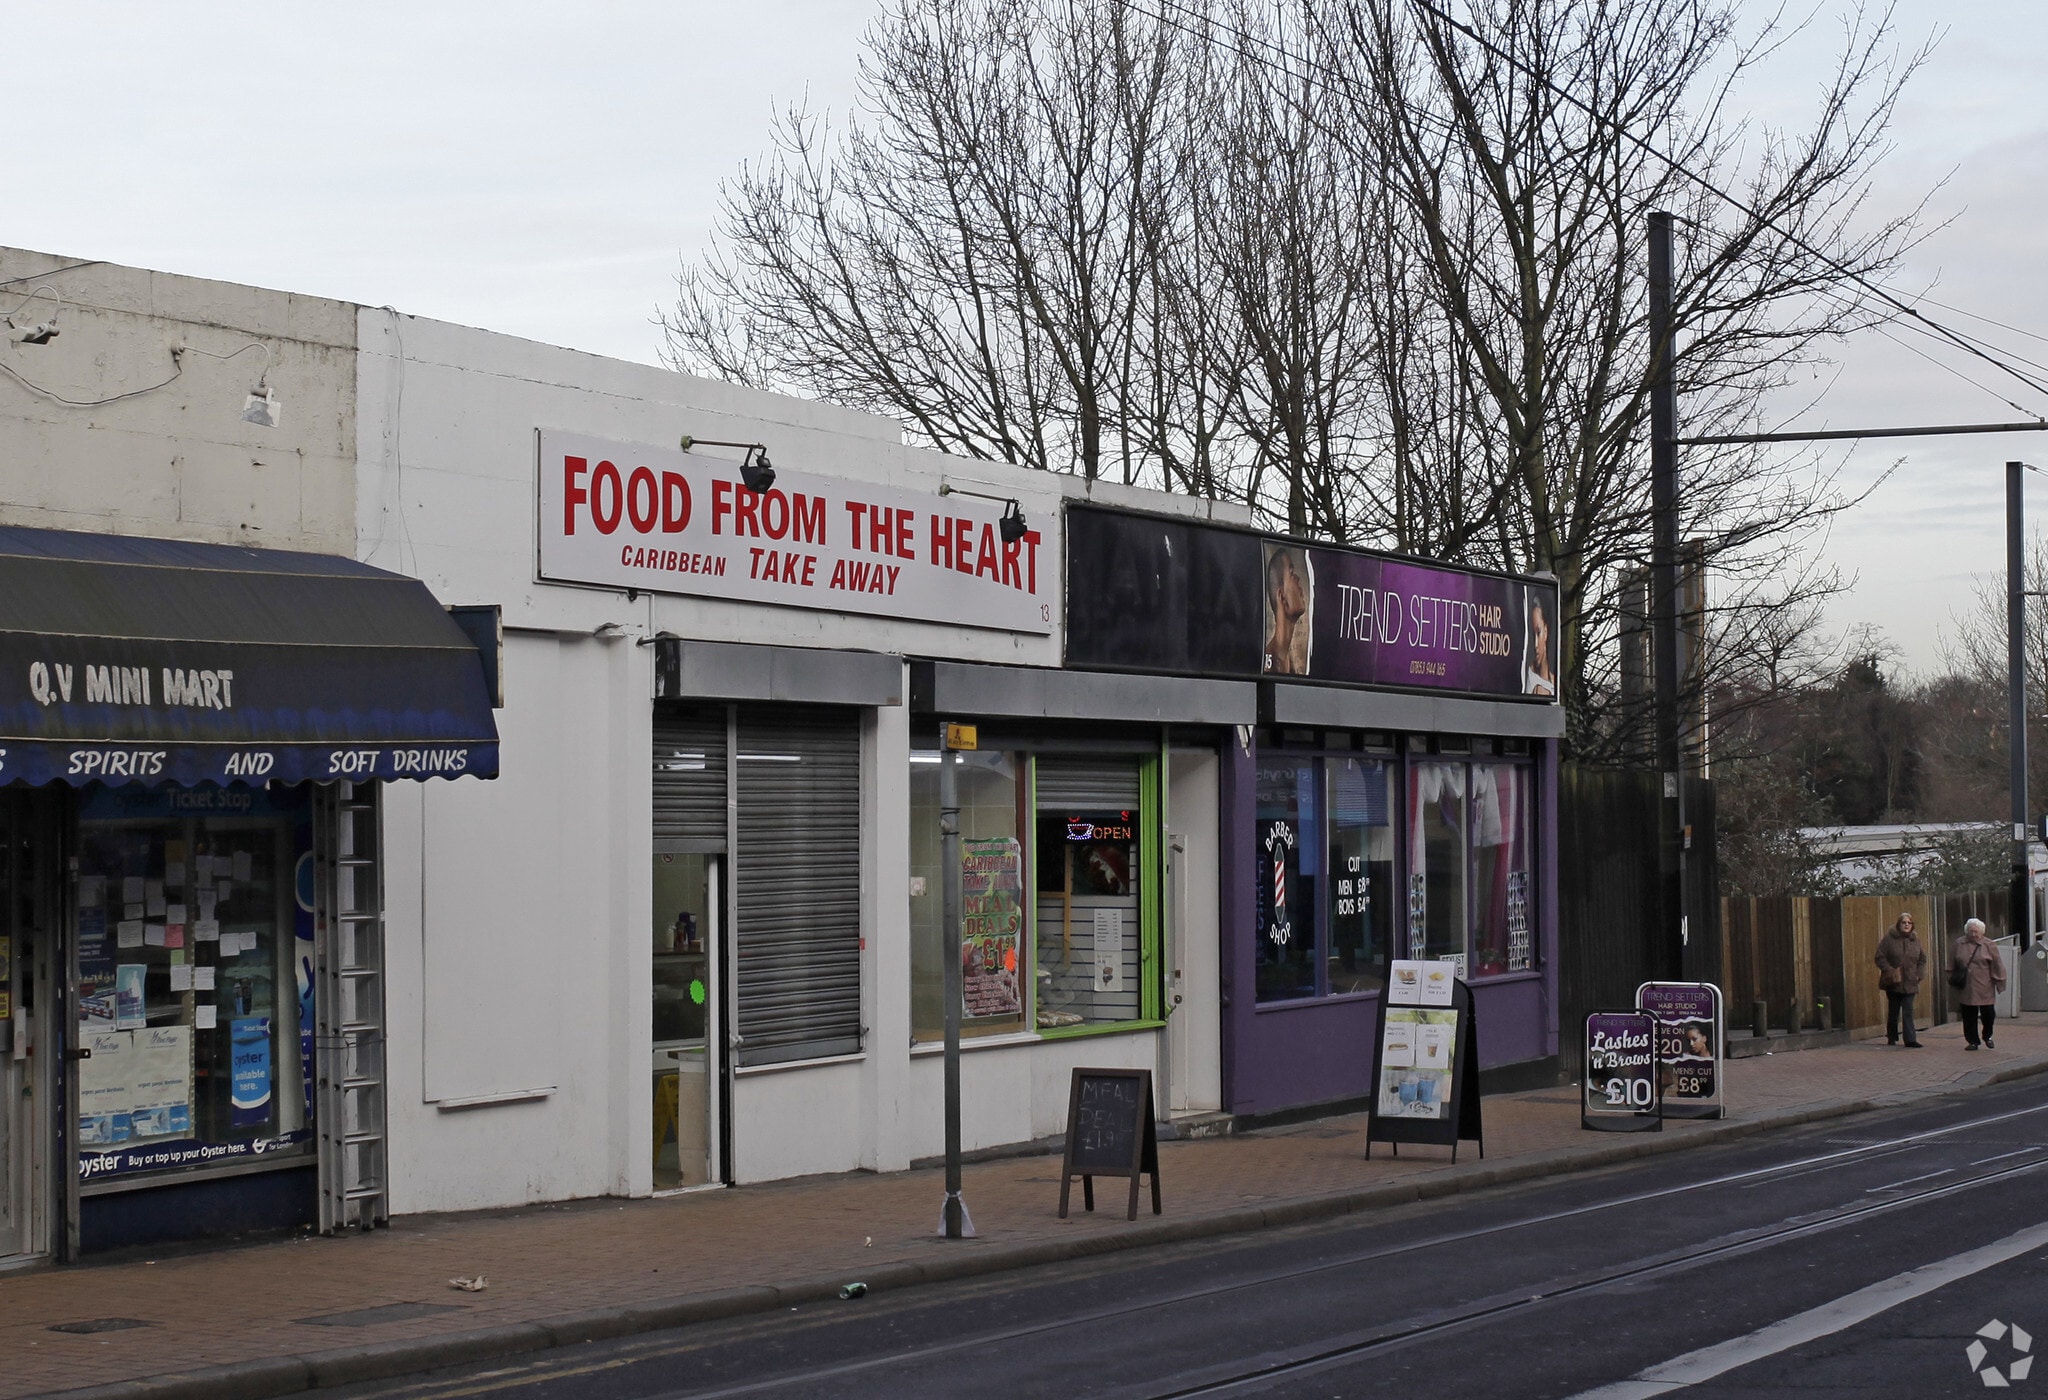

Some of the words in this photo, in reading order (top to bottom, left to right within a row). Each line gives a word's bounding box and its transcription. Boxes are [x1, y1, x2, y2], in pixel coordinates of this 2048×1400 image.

[563, 455, 692, 537] FOOD
[711, 478, 826, 546] FROM
[845, 501, 914, 560] THE
[930, 514, 1041, 596] HEART
[621, 544, 726, 577] CARIBBEAN
[749, 547, 816, 587] TAKE
[829, 558, 901, 596] AWAY
[1040, 604, 1050, 622] 13
[1337, 584, 1401, 645] TREND
[1408, 594, 1478, 654] SETTERS
[1479, 604, 1501, 629] HAIR
[1479, 634, 1511, 658] STUDIO
[29, 661, 73, 706] Q.V
[86, 664, 151, 705] MINI
[162, 667, 234, 711] MART
[68, 751, 167, 776] SPIRITS
[224, 752, 275, 776] AND
[328, 750, 381, 774] SOFT
[392, 749, 468, 772] DRINKS
[167, 787, 213, 809] Ticket
[217, 789, 252, 811] Stop
[1092, 826, 1131, 840] OPEN
[1265, 821, 1293, 852] BARBER
[962, 855, 1017, 872] CARIBBEAN
[1348, 857, 1360, 872] CUT
[963, 873, 989, 890] TAKE
[1338, 880, 1352, 895] MEN
[965, 896, 1015, 916] MEAL
[1339, 898, 1354, 915] BOYS
[966, 917, 1018, 936] DEALS
[1270, 921, 1291, 945] SHOP
[1647, 992, 1674, 1001] TREND
[1676, 993, 1710, 1002] SETTERS
[1591, 1029, 1649, 1053] Lashes
[1672, 1027, 1685, 1035] ON
[1606, 1051, 1651, 1069] Brows
[1083, 1080, 1134, 1103] MEAL
[1605, 1078, 1651, 1105] £10
[78, 1154, 120, 1177] oyster
[129, 1155, 144, 1167] Buy
[145, 1154, 154, 1163] or
[155, 1152, 169, 1164] top
[170, 1151, 181, 1162] up
[182, 1149, 200, 1161] your
[201, 1145, 226, 1158] Oyster
[227, 1143, 247, 1153] here.
